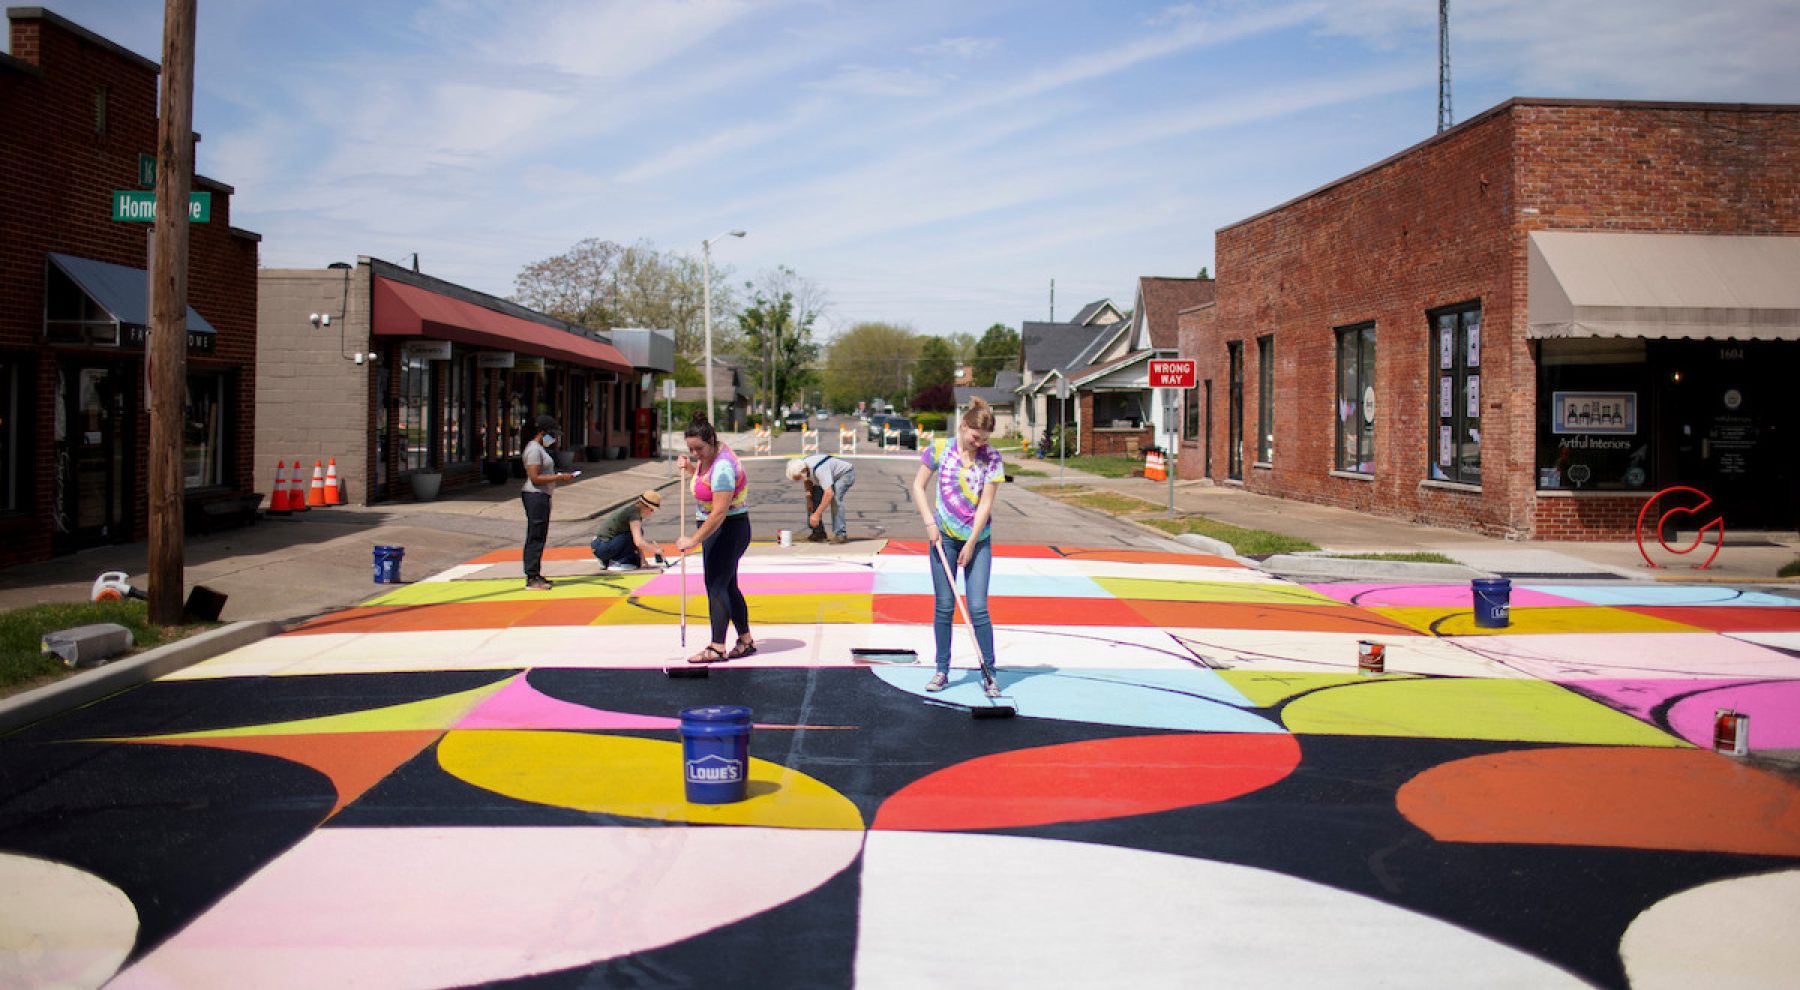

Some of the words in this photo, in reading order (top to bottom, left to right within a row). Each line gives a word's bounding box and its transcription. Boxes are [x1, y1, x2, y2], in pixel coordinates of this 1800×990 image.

[1720, 348, 1744, 360] 1604
[1154, 363, 1190, 373] WRONG
[1161, 375, 1183, 385] WAY
[1559, 434, 1588, 449] Artful
[1590, 438, 1631, 449] Interiors
[689, 764, 738, 780] LOWE'S
